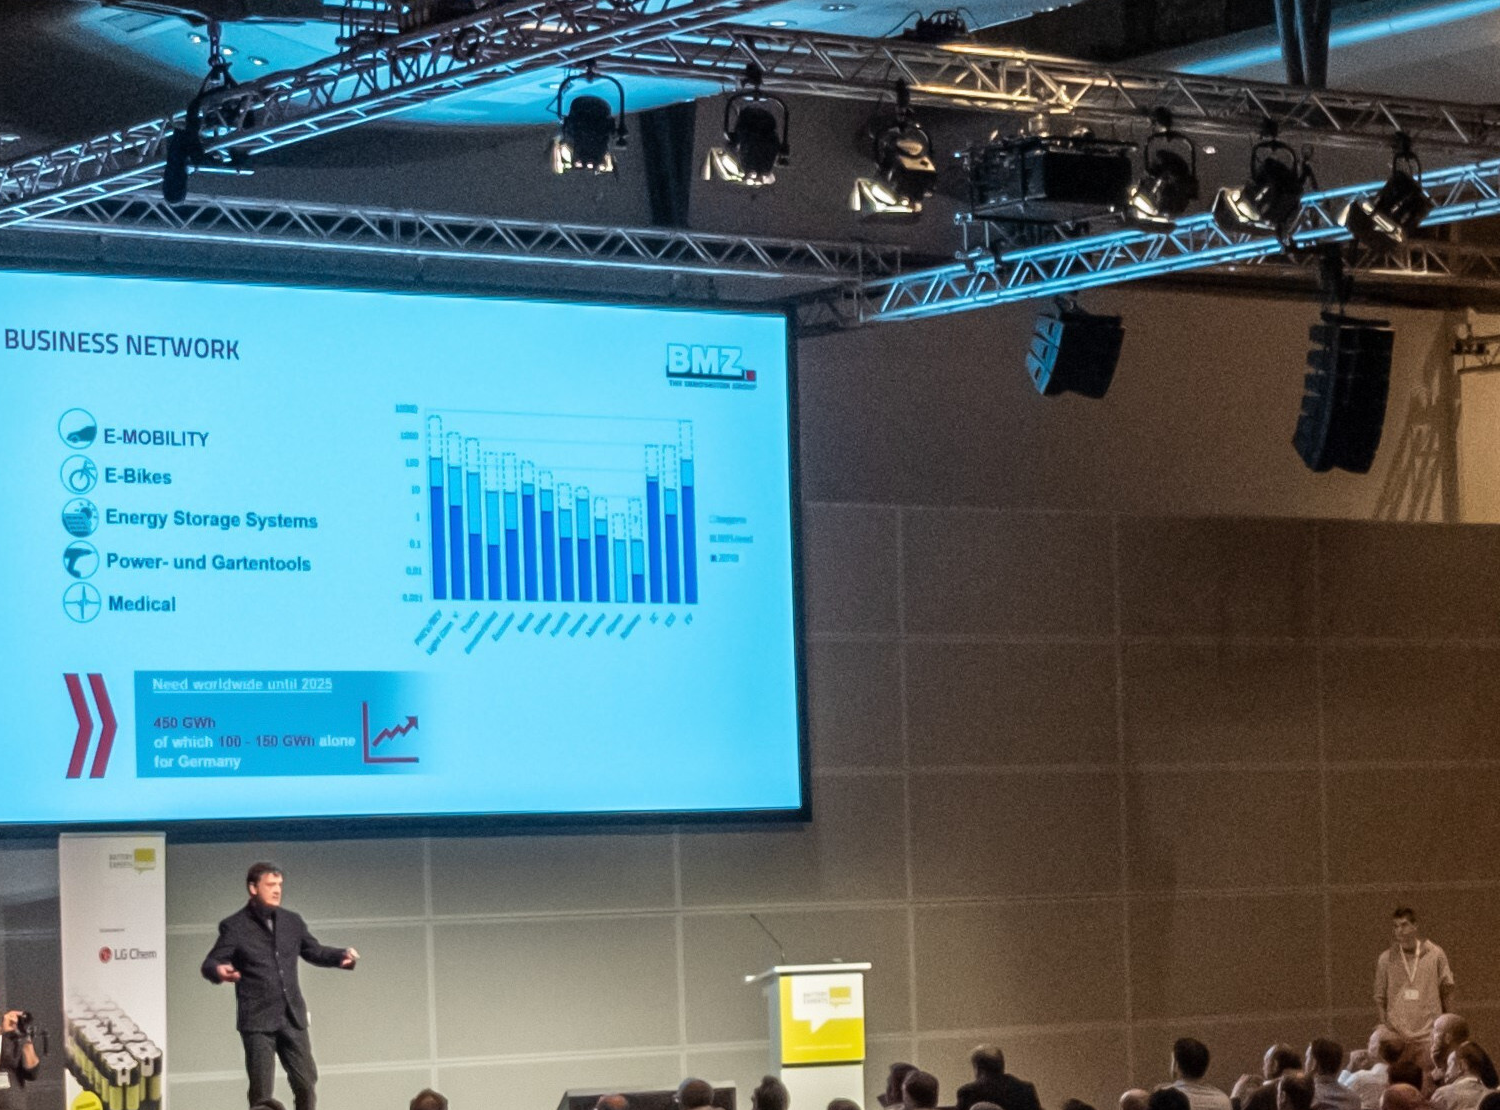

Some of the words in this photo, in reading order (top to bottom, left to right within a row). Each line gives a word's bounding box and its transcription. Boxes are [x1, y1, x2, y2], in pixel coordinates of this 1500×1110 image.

[5, 328, 119, 355] BUSINESS
[126, 335, 240, 360] NETWORK
[667, 342, 743, 377] BMZ
[104, 428, 210, 447] E-MOBILITY
[105, 467, 172, 485] E-Bikes
[105, 508, 168, 530] Energy
[173, 510, 241, 531] Storage
[245, 511, 318, 531] Systems
[106, 552, 169, 570] Power-
[173, 554, 207, 570] und
[211, 554, 312, 572] Gartentools
[108, 595, 176, 612] Medical
[152, 678, 189, 691] Need
[193, 678, 264, 691] worldwide
[268, 678, 298, 691] until
[301, 677, 333, 691] 2025
[153, 716, 178, 729] 450
[182, 716, 216, 729] GWh
[153, 735, 168, 748] of
[172, 735, 213, 748] which
[218, 735, 242, 748] 100
[255, 734, 278, 748] 150
[282, 734, 315, 747] GWh
[319, 734, 357, 748] alone
[153, 754, 174, 769] for
[177, 754, 242, 770] Germany
[114, 948, 128, 961] LG
[129, 947, 158, 960] Chem
